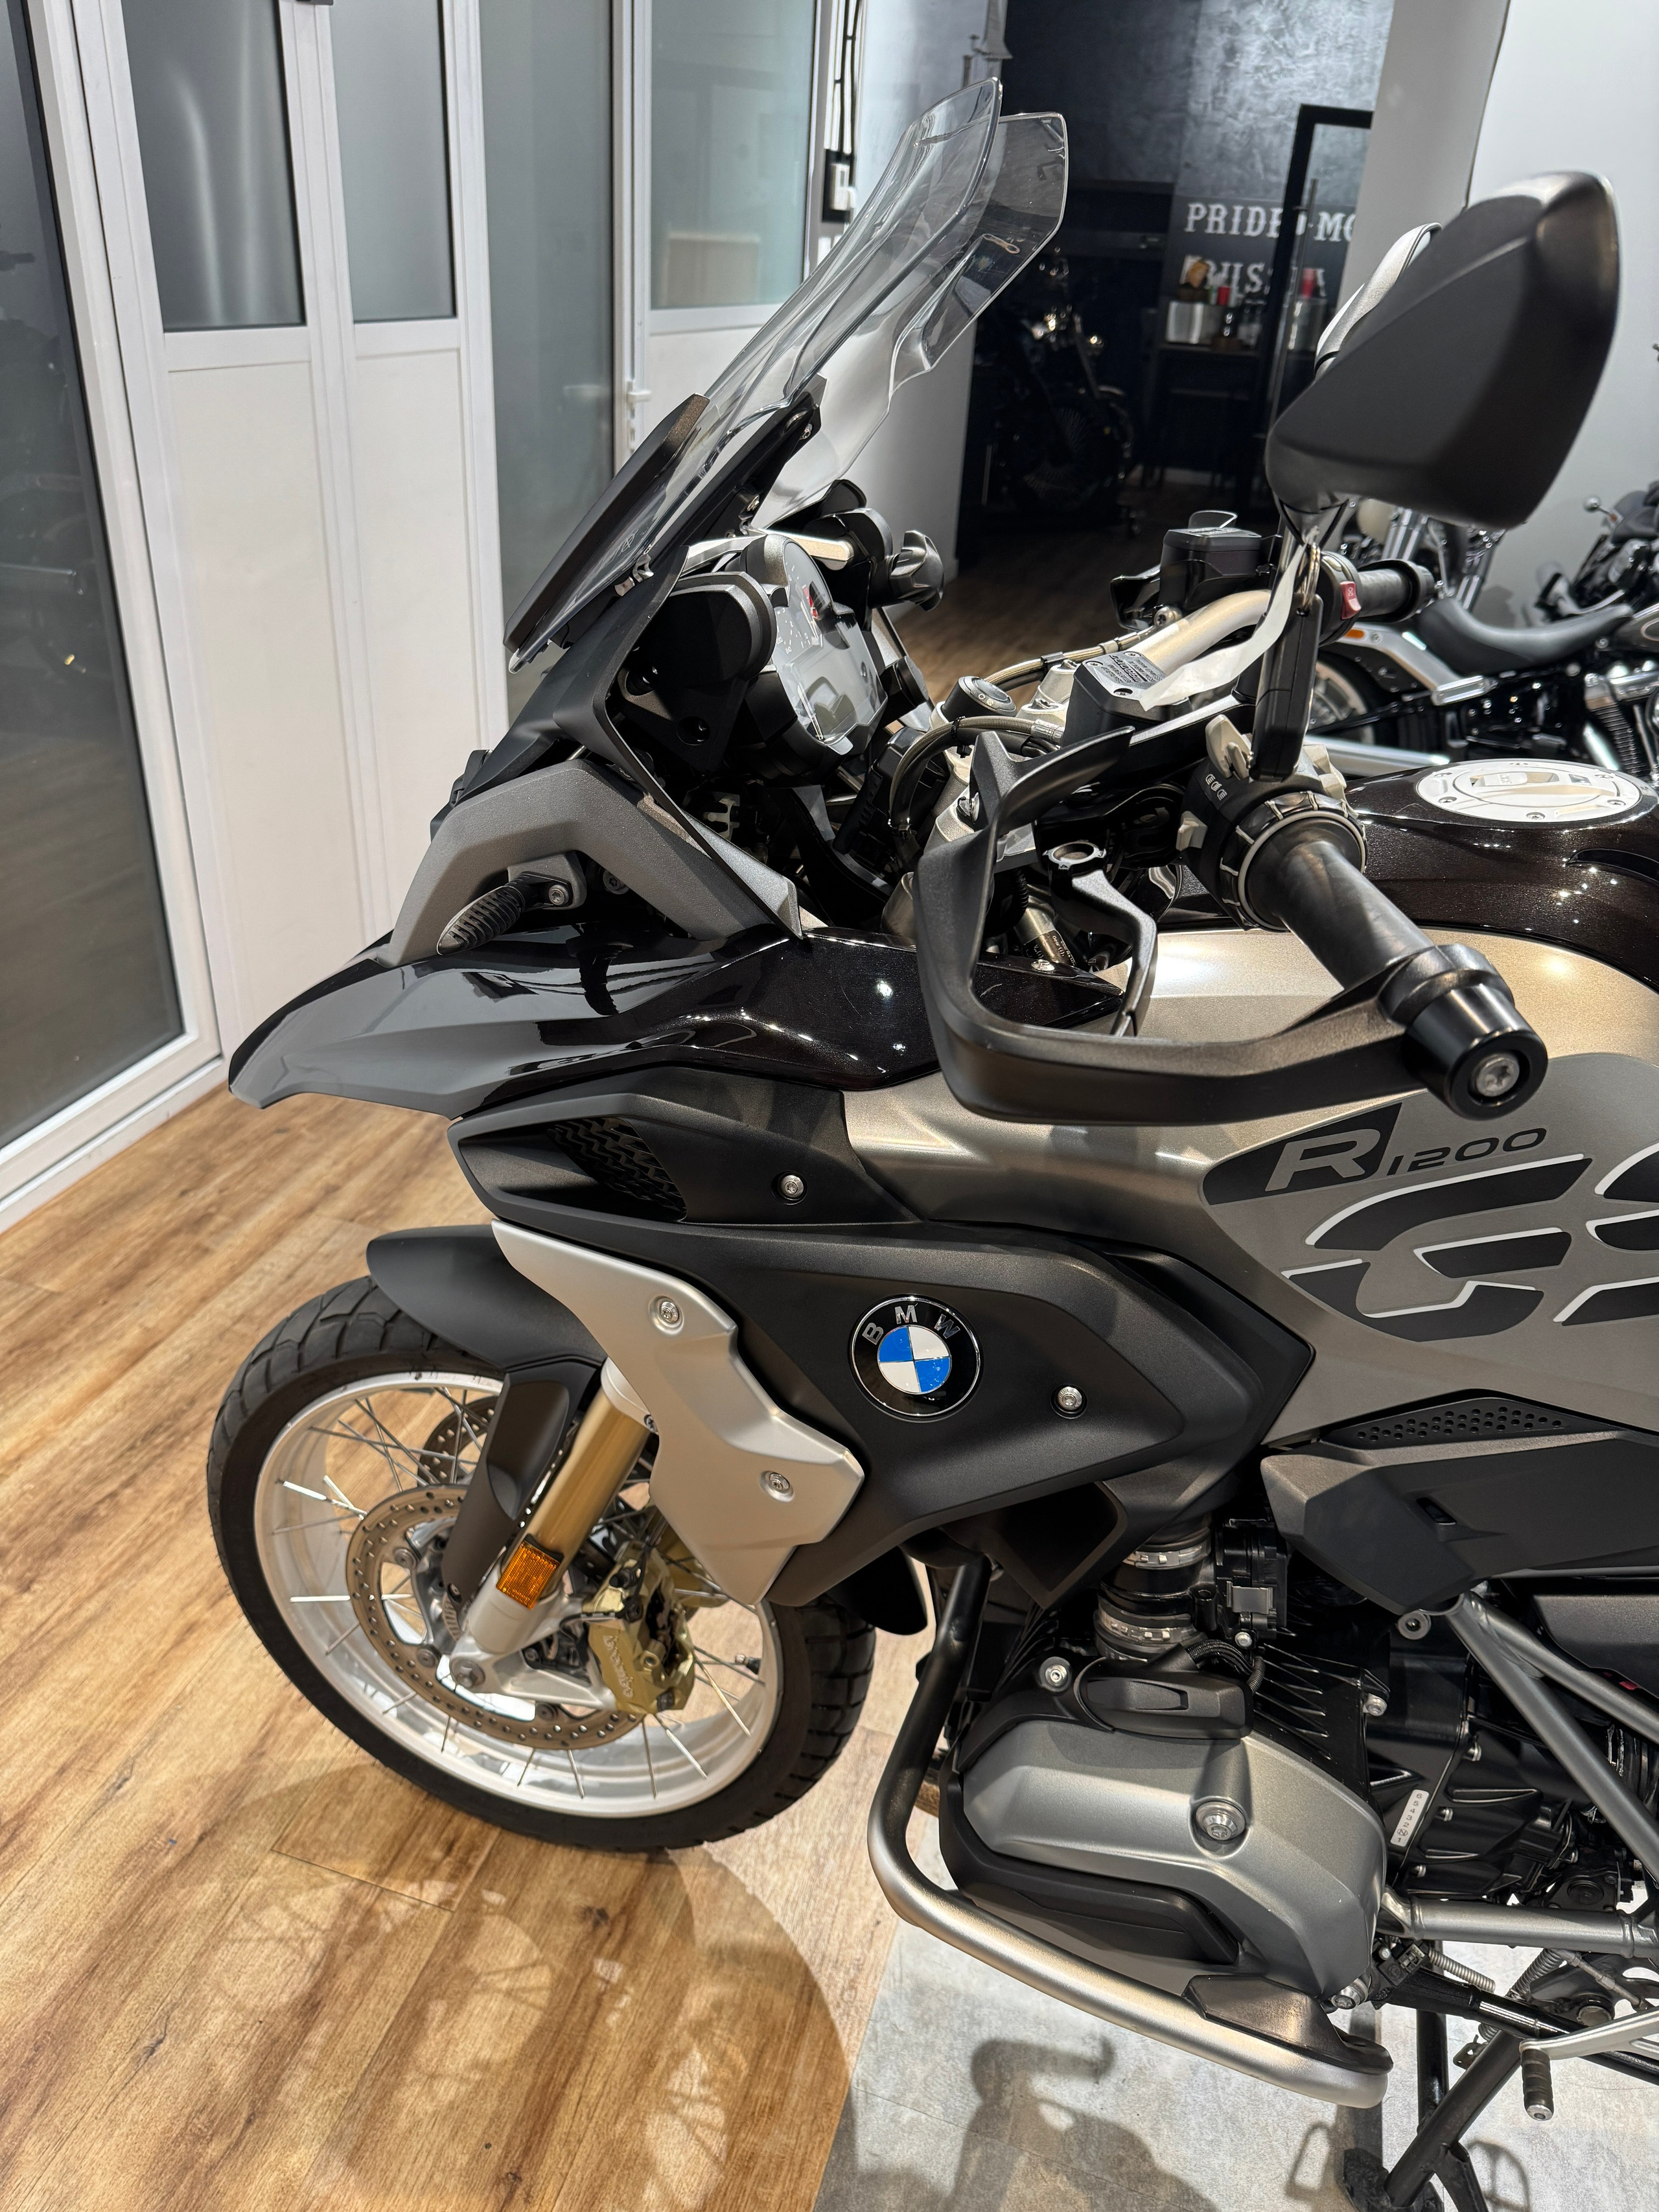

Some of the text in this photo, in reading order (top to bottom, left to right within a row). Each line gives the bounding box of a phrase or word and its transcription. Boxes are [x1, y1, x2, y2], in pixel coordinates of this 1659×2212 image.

[1265, 1128, 1548, 1192] R 1200
[862, 1305, 960, 1345] BMW
